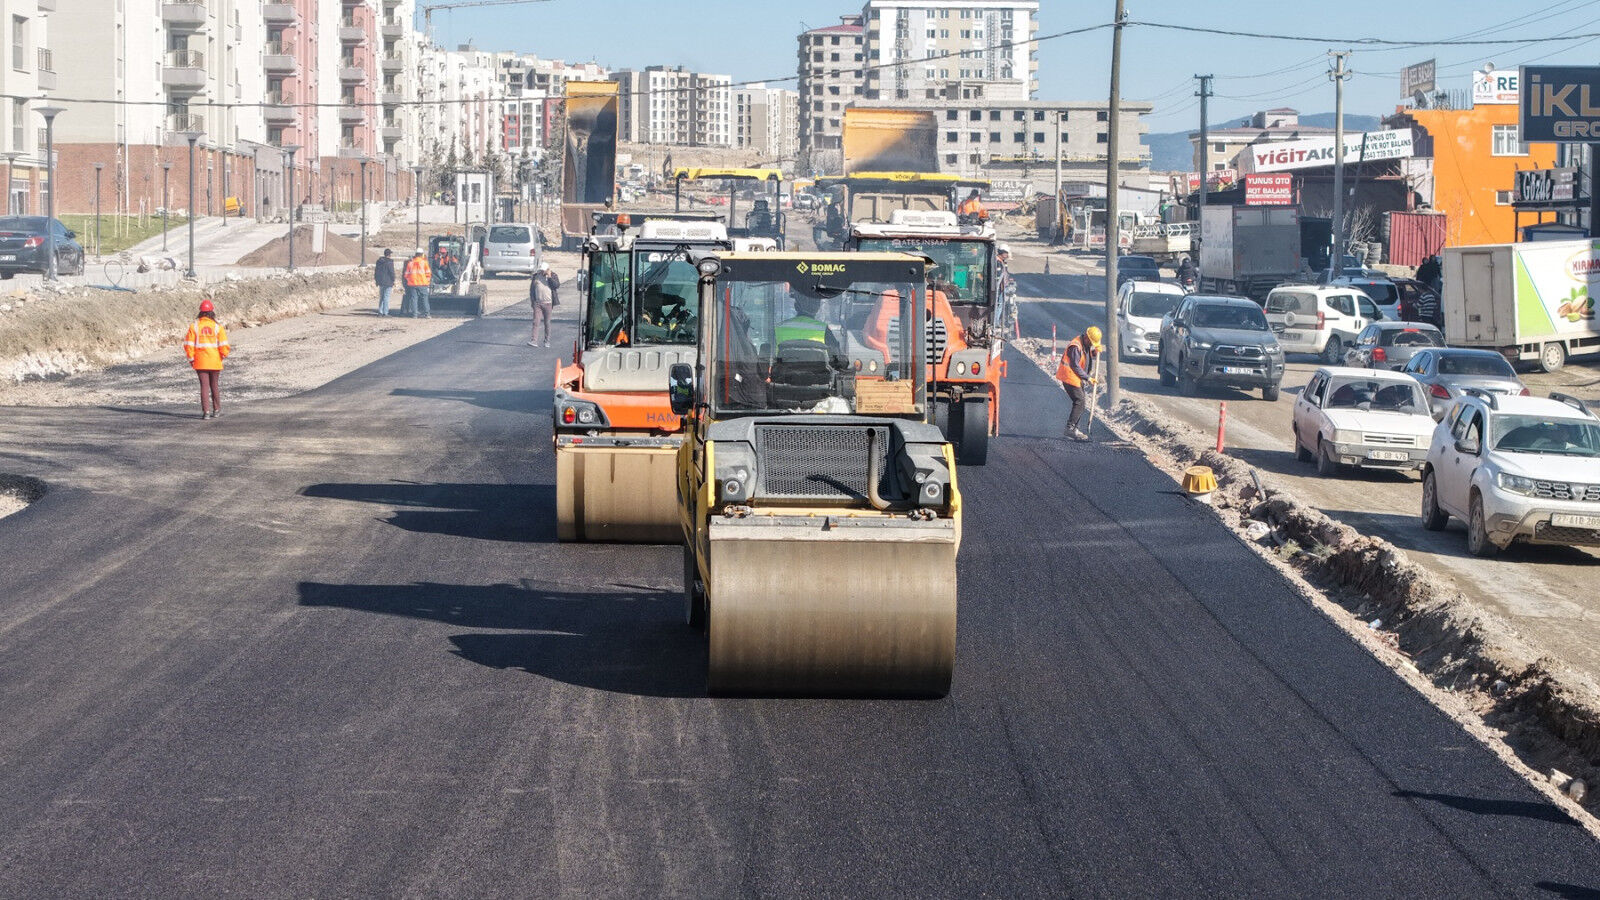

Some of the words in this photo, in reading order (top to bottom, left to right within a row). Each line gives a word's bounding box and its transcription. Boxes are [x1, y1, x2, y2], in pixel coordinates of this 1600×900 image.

[1386, 132, 1396, 140] OTO
[1379, 141, 1389, 149] ROT
[1391, 139, 1412, 148] BALANS
[1257, 142, 1348, 165] YİĞİTAK
[1248, 177, 1273, 185] YUNUS
[1275, 177, 1290, 185] OTO
[1523, 170, 1551, 201] Gözde
[1247, 187, 1261, 195] ROT
[1263, 187, 1290, 195] BALANS
[811, 264, 846, 272] BOMAG
[647, 411, 679, 423] HAM
